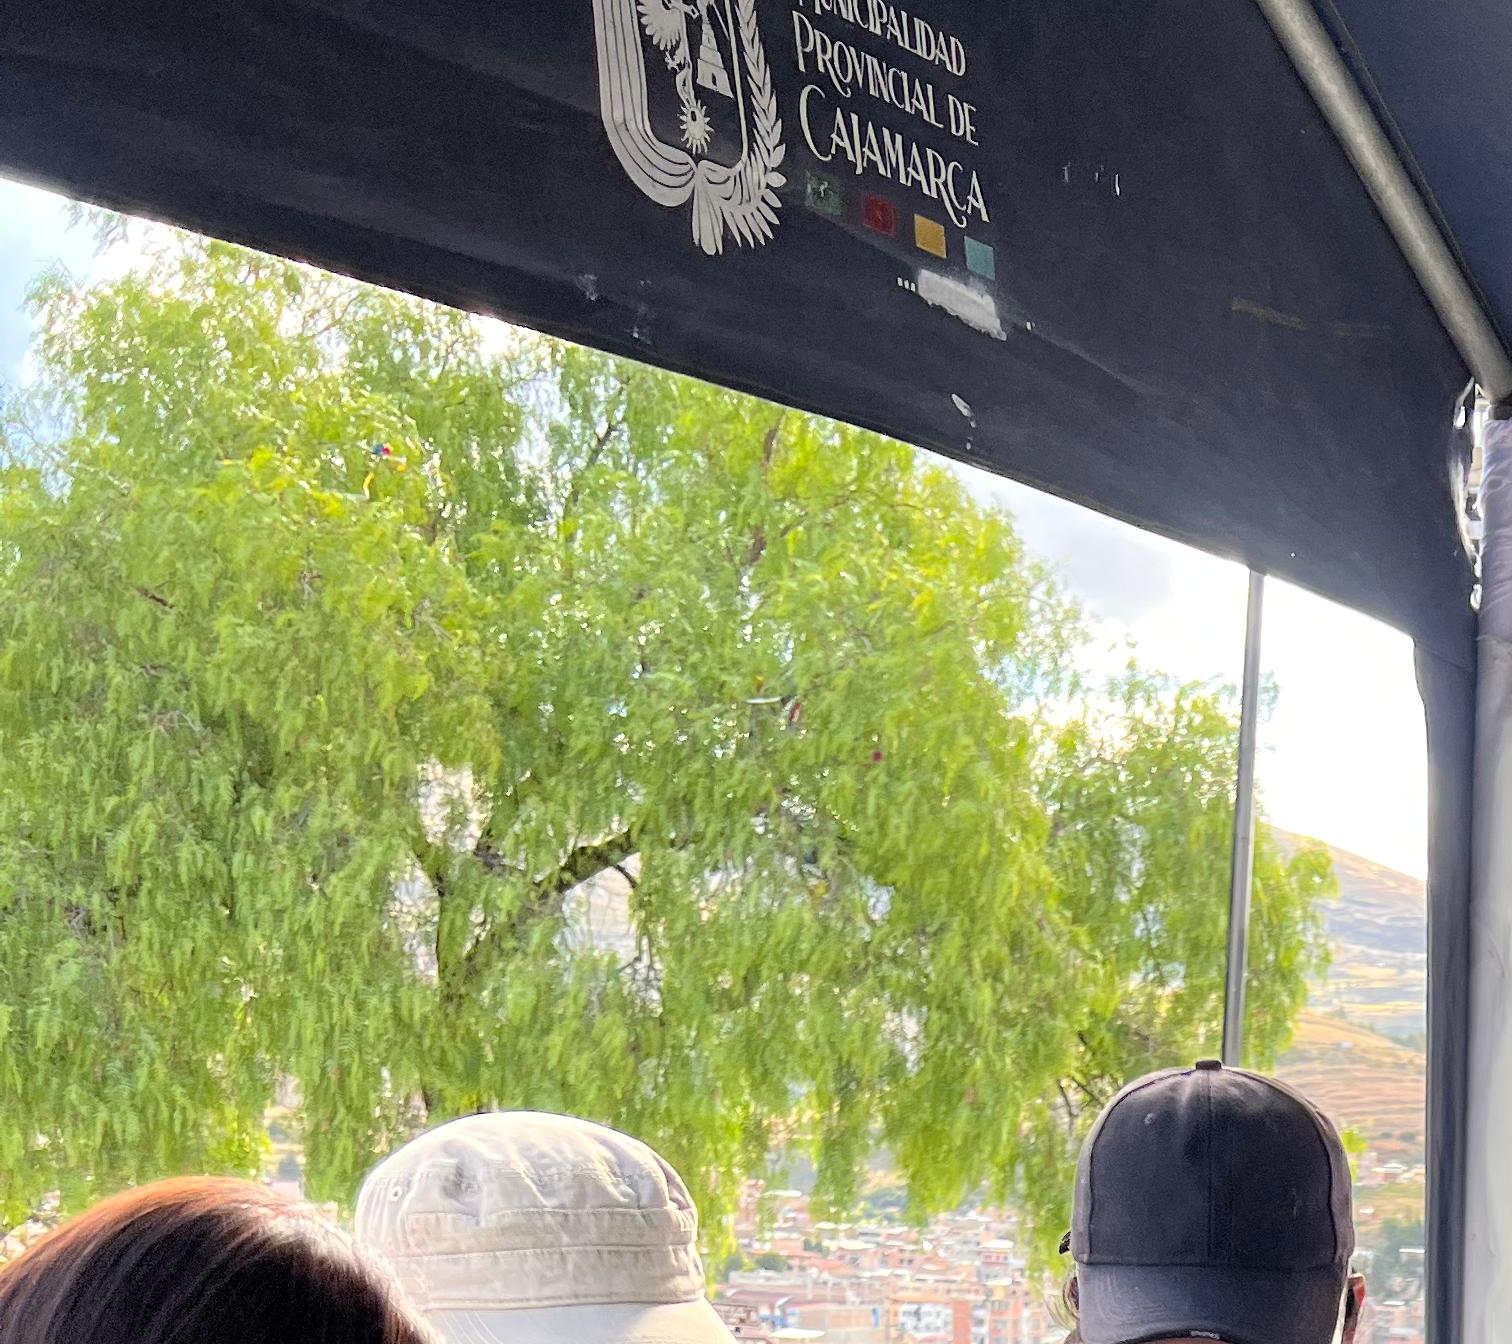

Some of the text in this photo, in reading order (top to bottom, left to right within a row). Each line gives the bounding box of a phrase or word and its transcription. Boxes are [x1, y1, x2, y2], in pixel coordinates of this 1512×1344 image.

[792, 10, 979, 146] PROVINCIAL DE
[798, 0, 966, 76] NICIPALIDAD
[799, 84, 990, 229] CAJAMARCA
